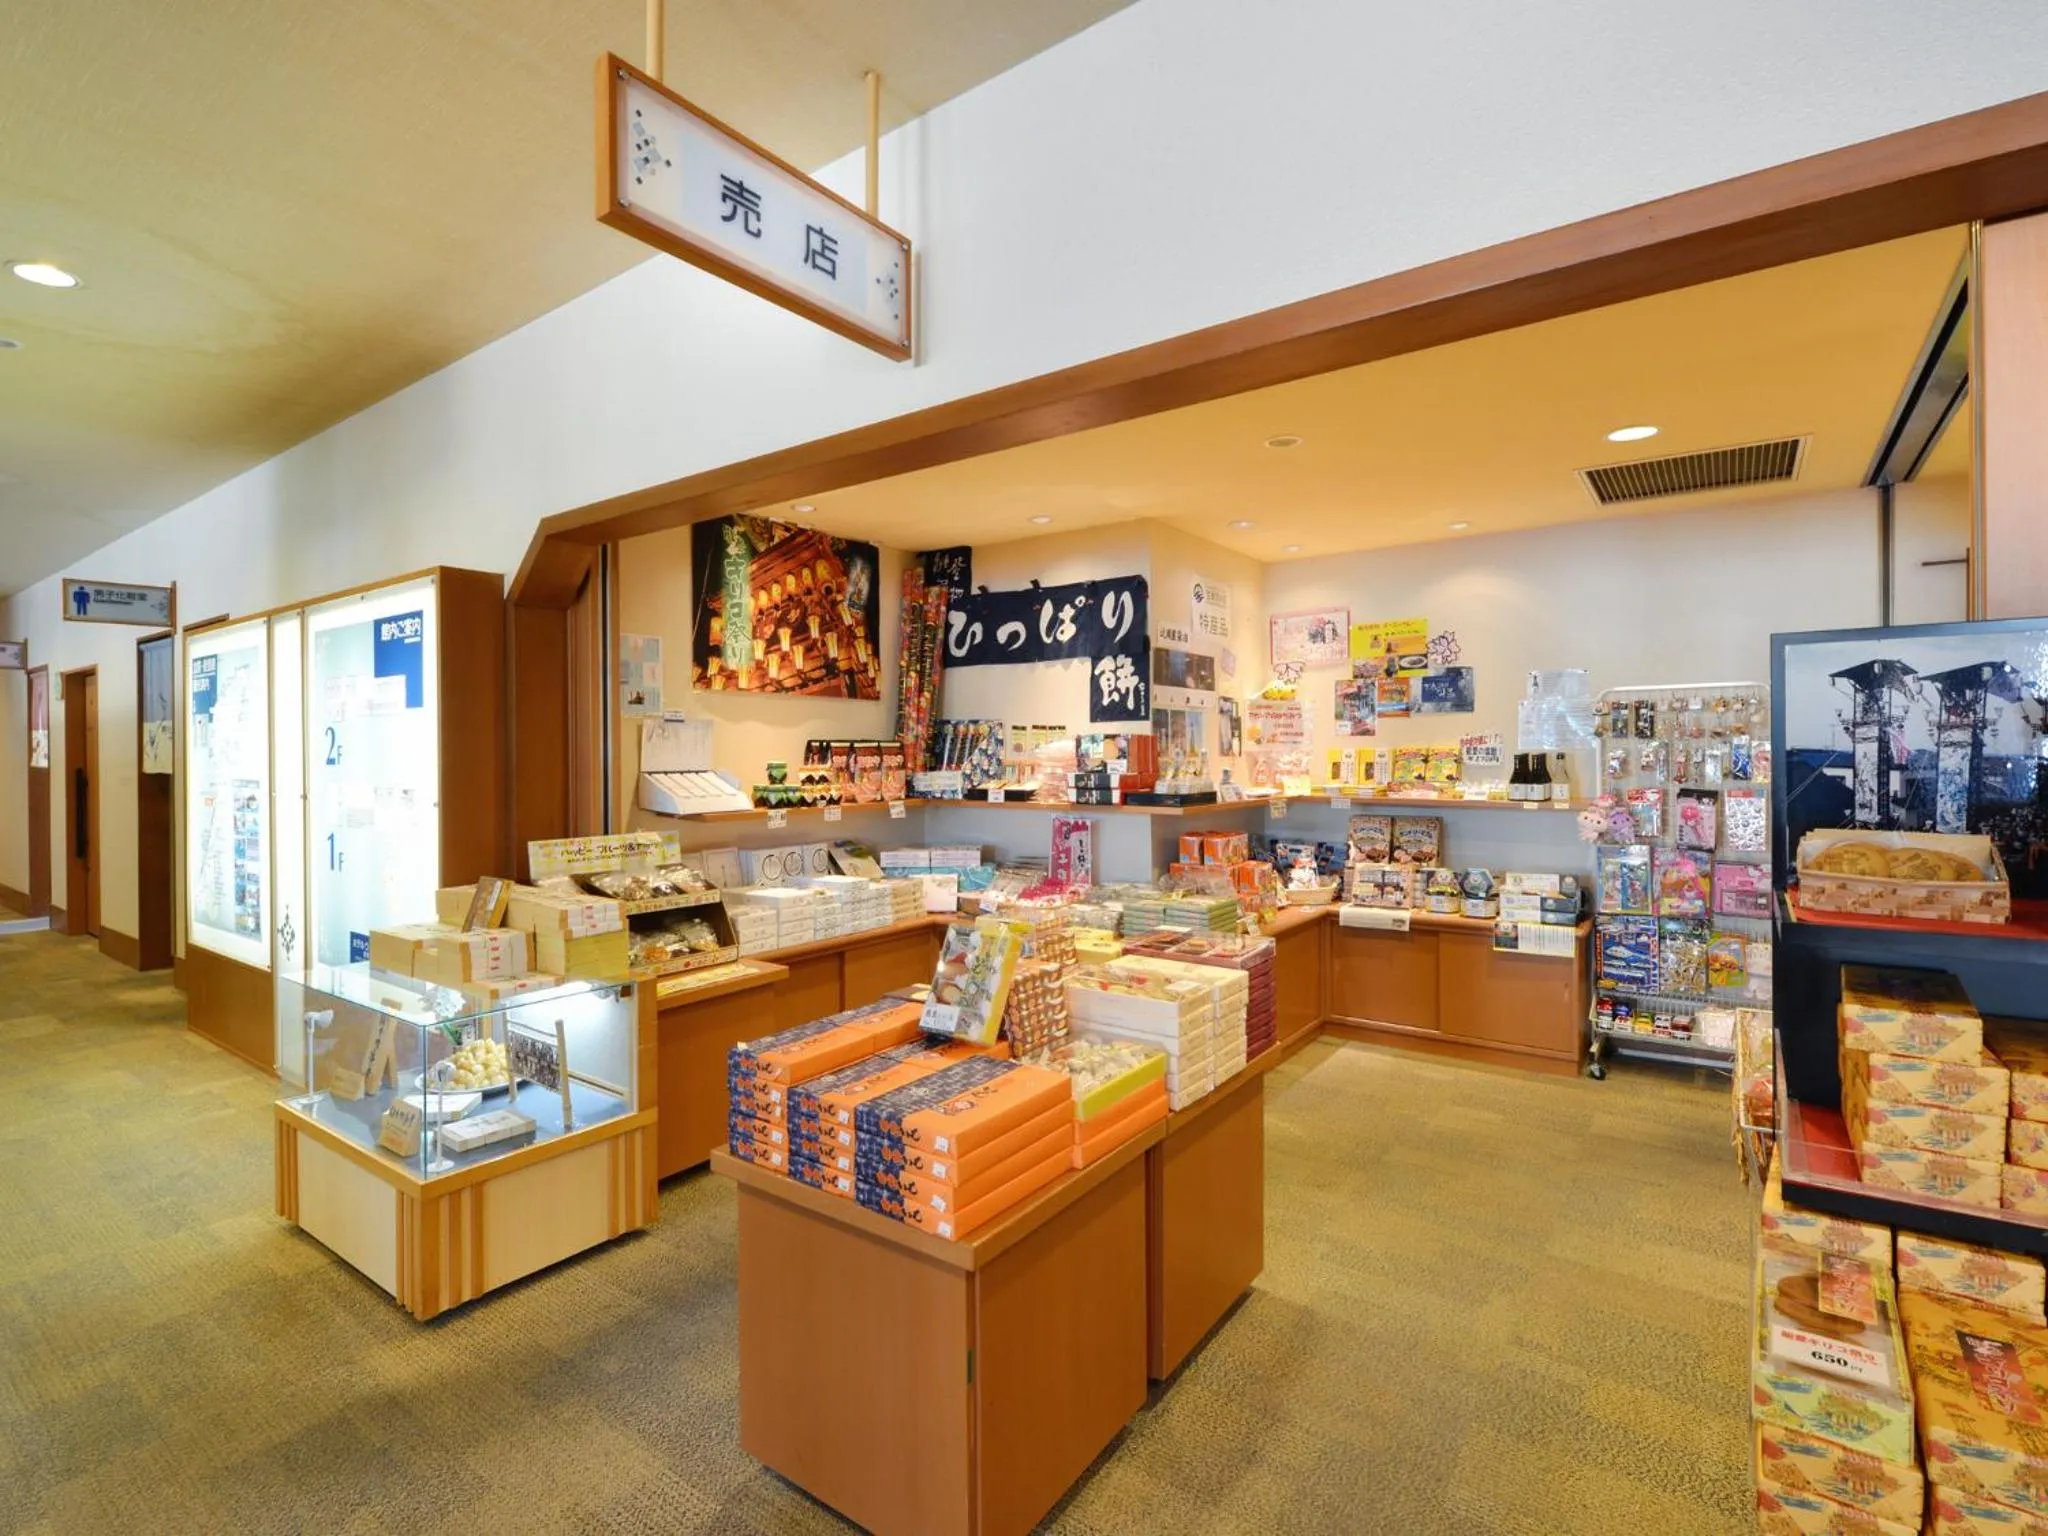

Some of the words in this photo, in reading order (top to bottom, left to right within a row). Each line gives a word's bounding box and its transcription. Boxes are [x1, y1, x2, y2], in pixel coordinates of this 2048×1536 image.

[720, 173, 839, 281] 売店
[948, 590, 1135, 658] ひっぱり
[325, 726, 343, 766] 2F
[327, 832, 345, 873] 1F
